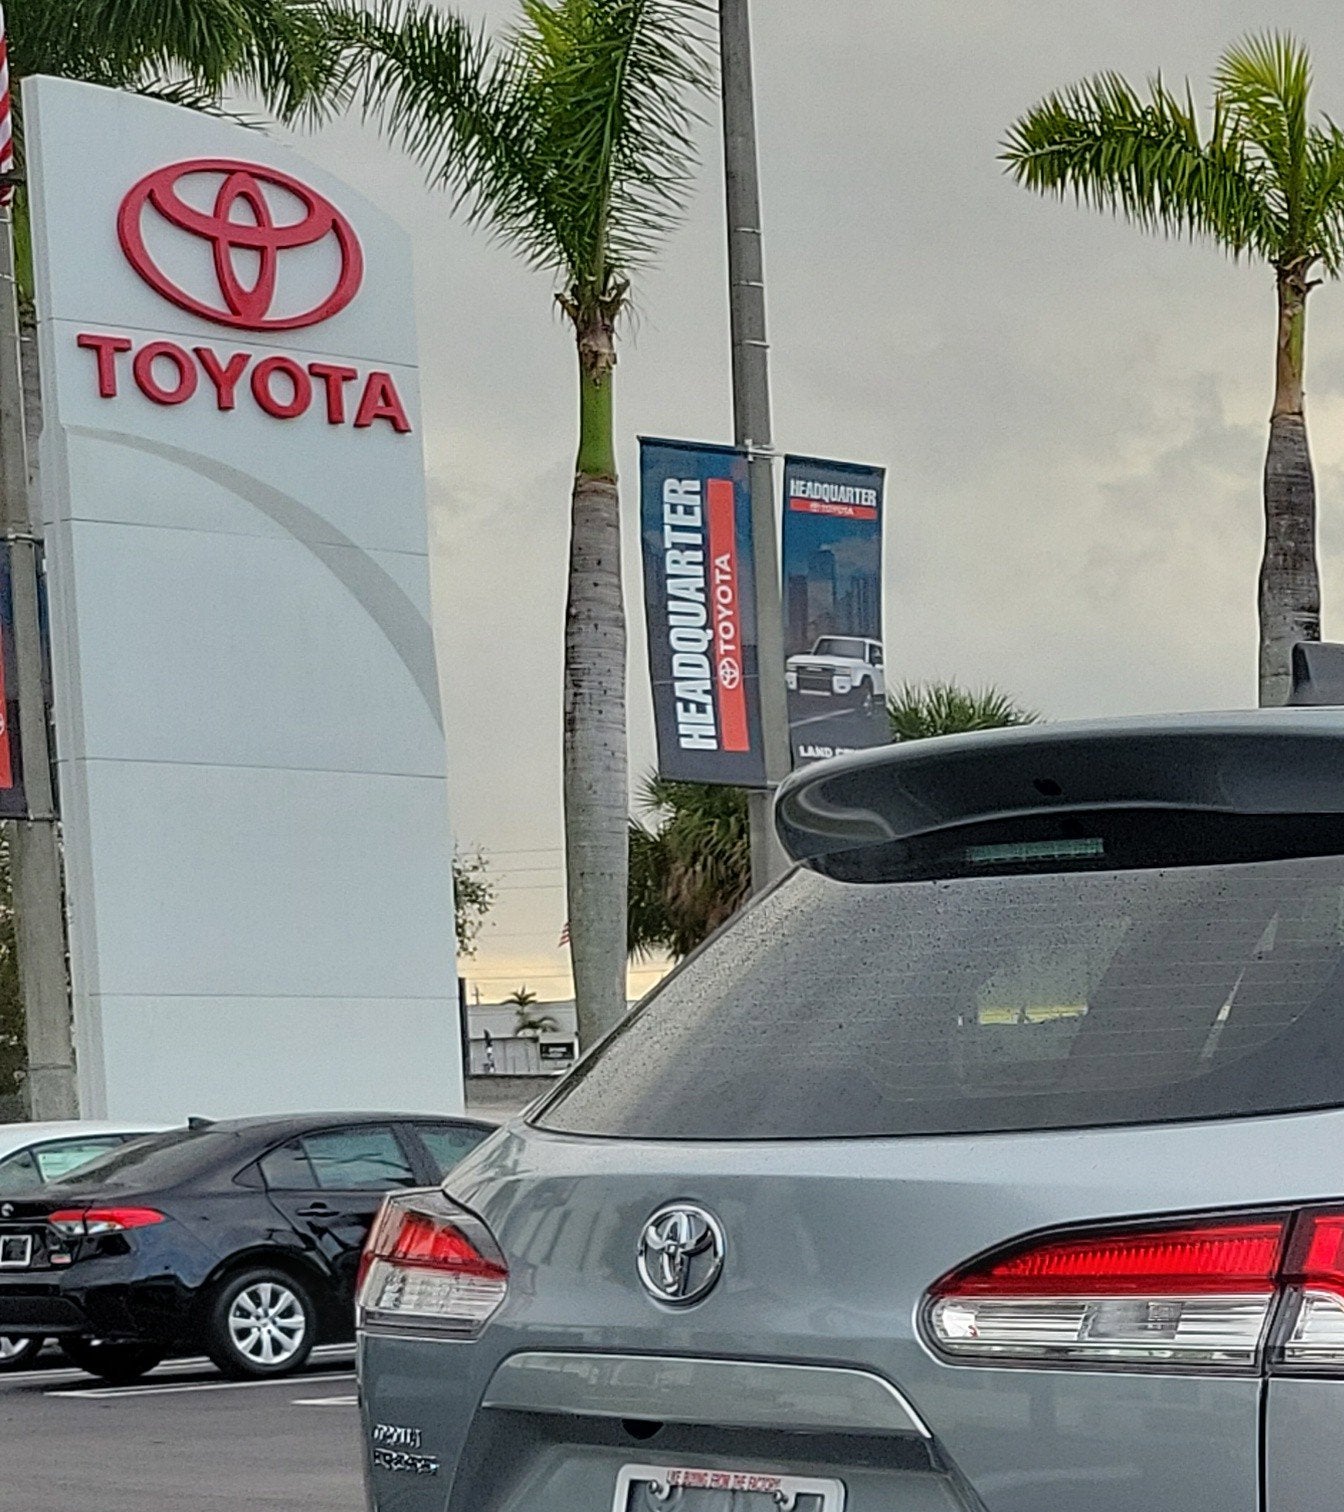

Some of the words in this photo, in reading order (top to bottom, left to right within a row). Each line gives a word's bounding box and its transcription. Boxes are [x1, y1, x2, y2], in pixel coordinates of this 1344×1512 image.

[77, 333, 412, 434] TOYOTA
[790, 479, 877, 507] HEADQUARTER
[663, 478, 719, 751] HEADQUARTER
[714, 552, 736, 656] TOYOTA
[799, 745, 833, 759] LAND
